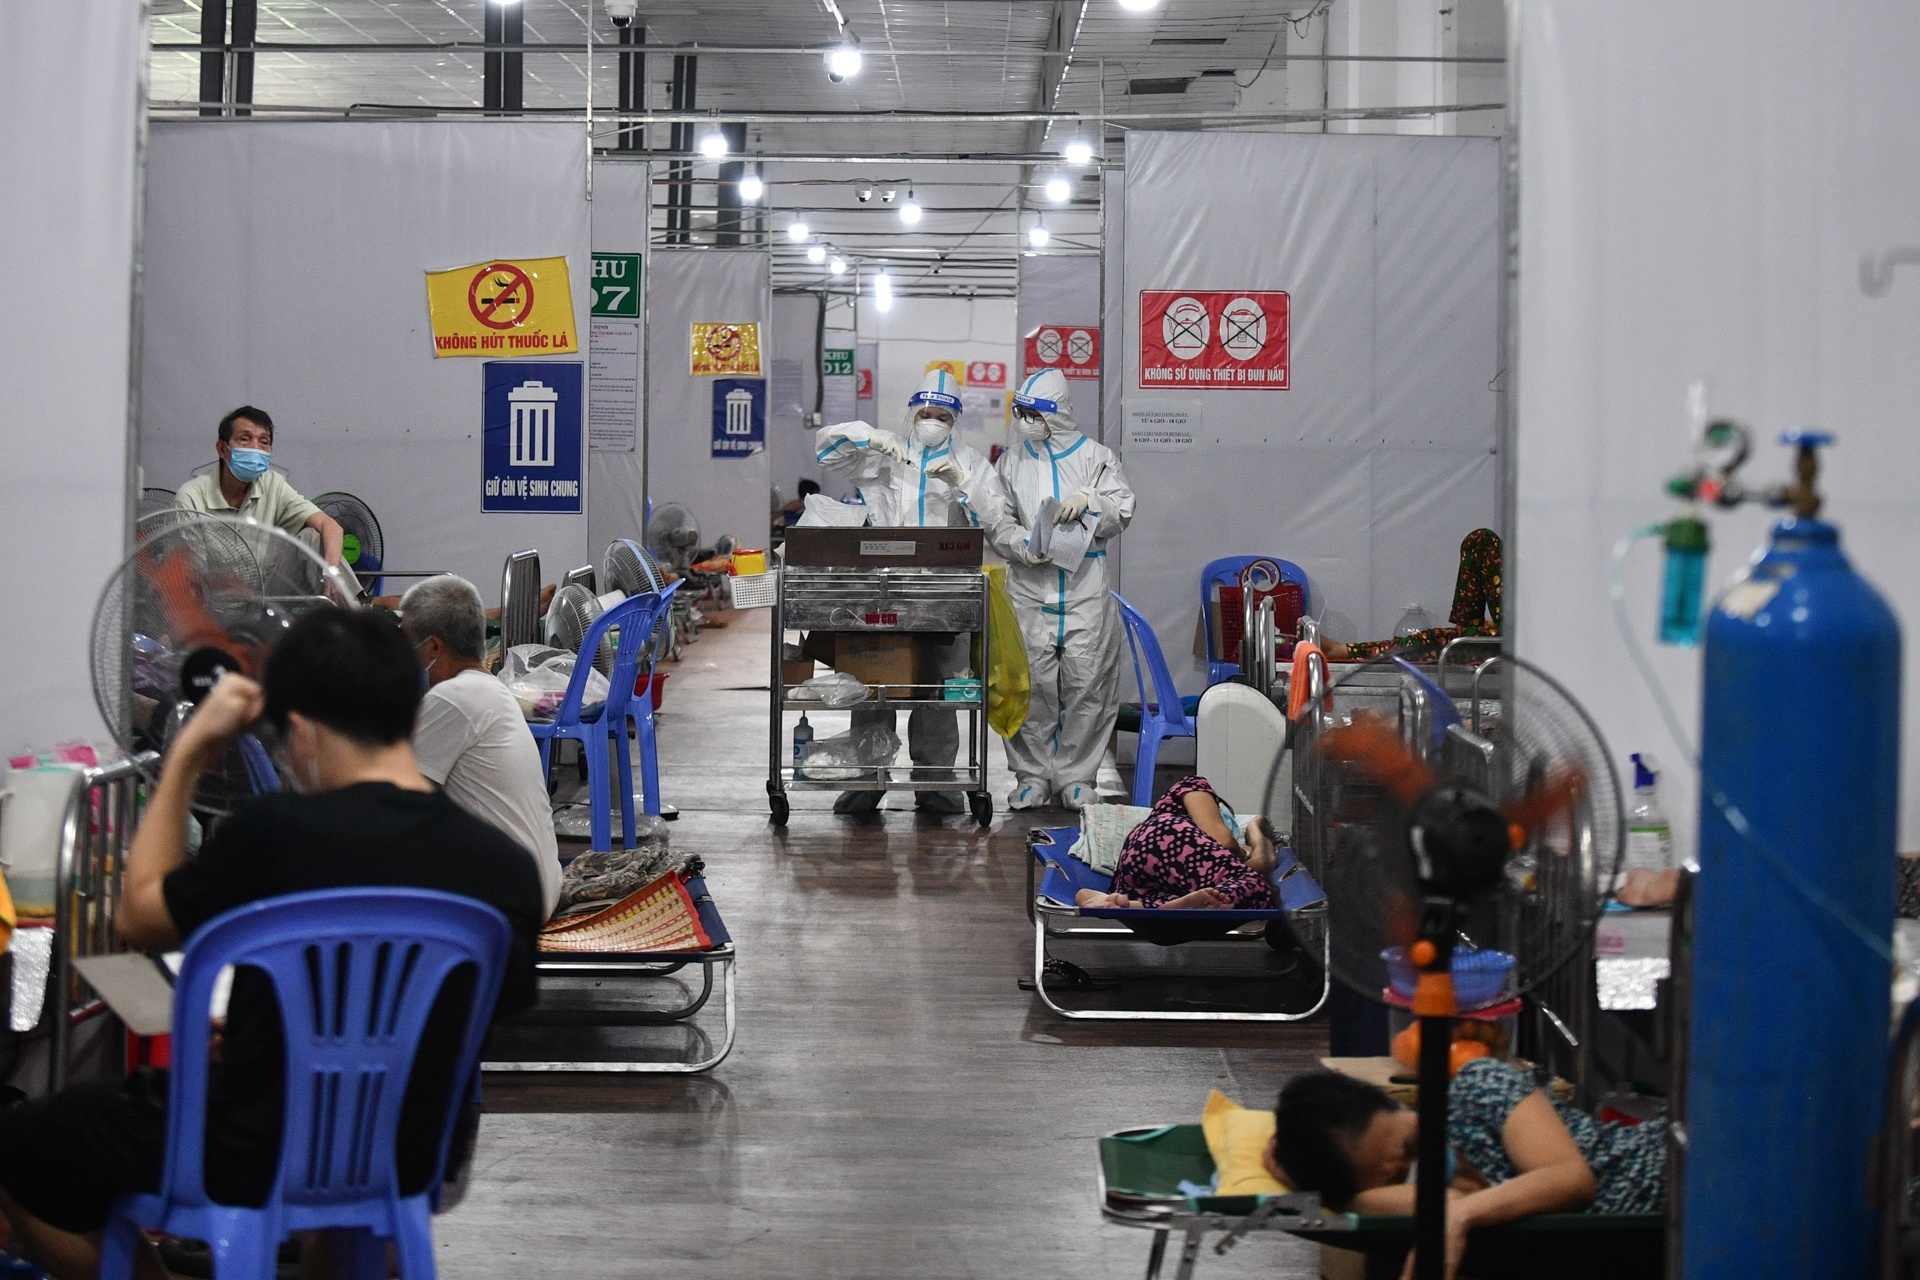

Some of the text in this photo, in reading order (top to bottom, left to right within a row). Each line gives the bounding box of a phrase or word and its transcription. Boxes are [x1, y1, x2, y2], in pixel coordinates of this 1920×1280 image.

[435, 329, 569, 350] KHÔNG HÚT THUỐC LÁ
[1145, 364, 1285, 384] KHÔNG SỬ DỤNG THIẾT BỊ ĐUN NẤU
[485, 475, 579, 501] GIỮ GÌN VỆ SINH CHUNG
